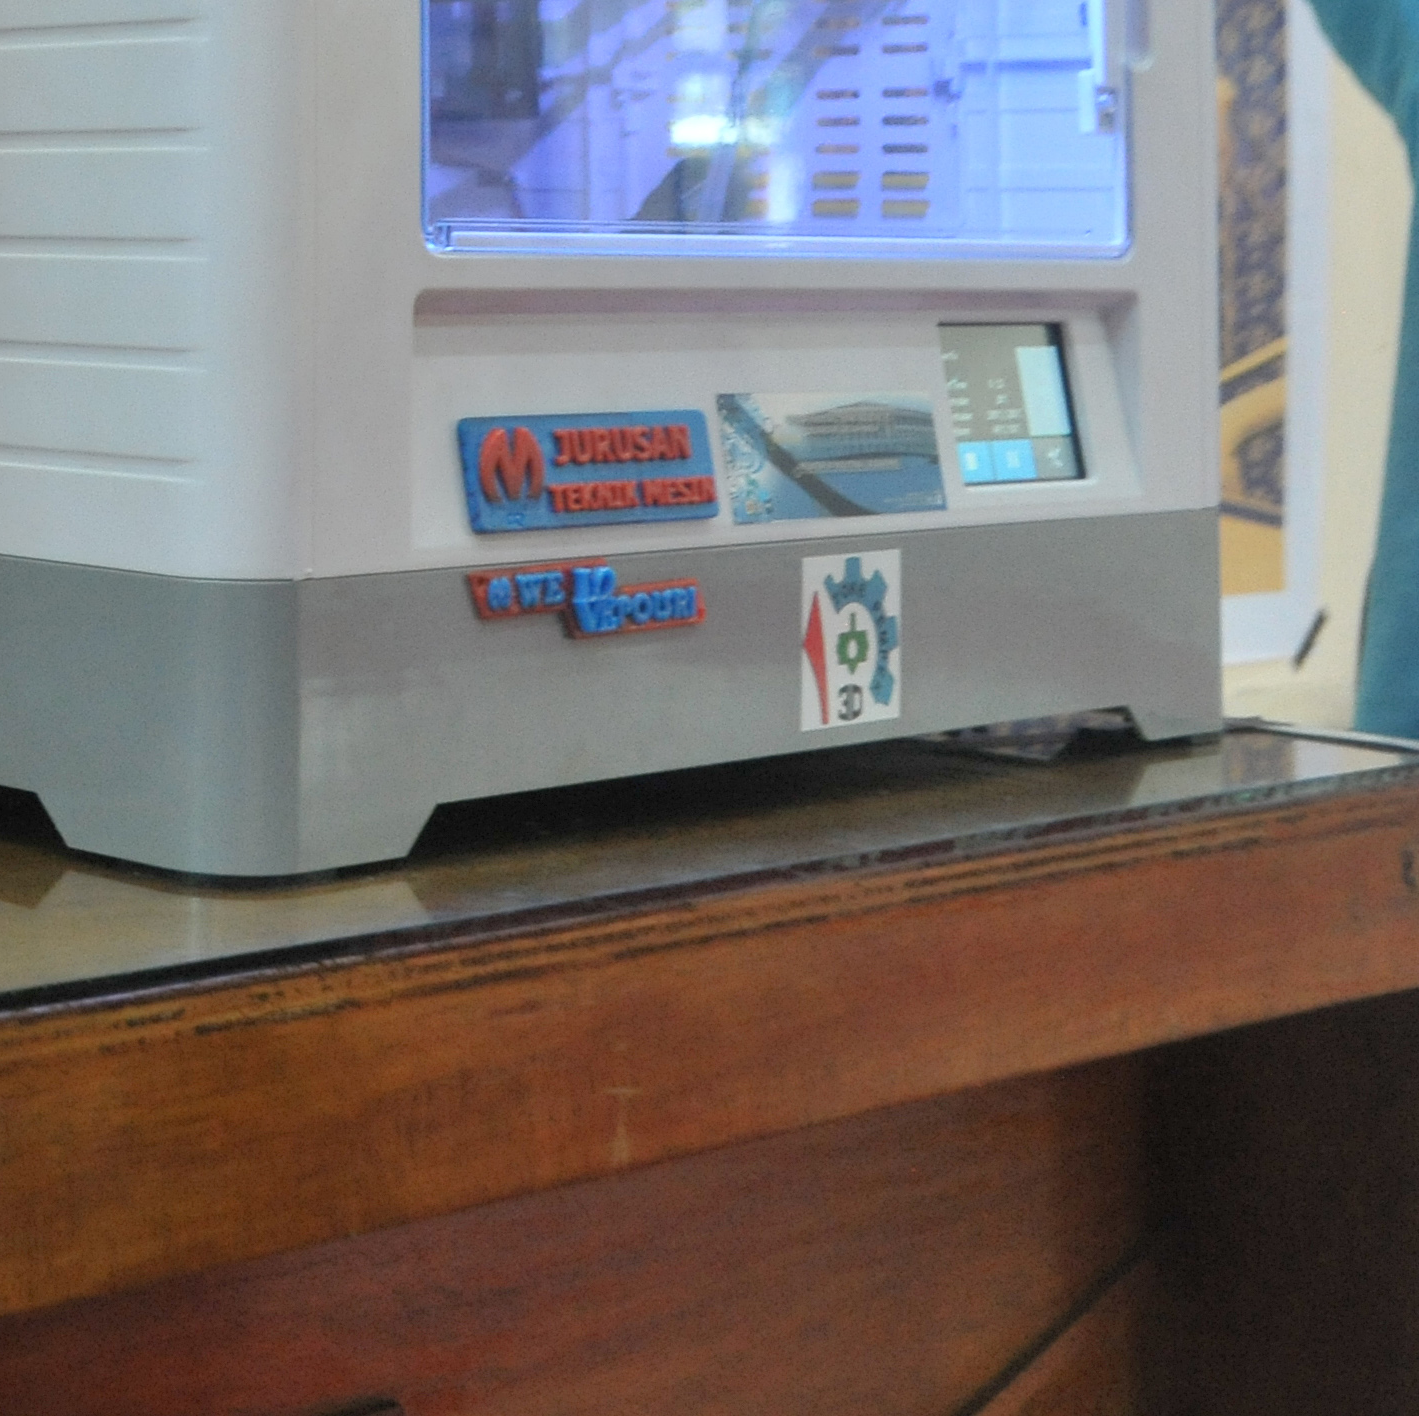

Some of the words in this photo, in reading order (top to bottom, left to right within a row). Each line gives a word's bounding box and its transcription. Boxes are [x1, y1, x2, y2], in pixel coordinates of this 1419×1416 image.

[553, 424, 692, 466] JURUSAN
[547, 479, 640, 514] TEKNIK
[641, 474, 719, 507] MESIN
